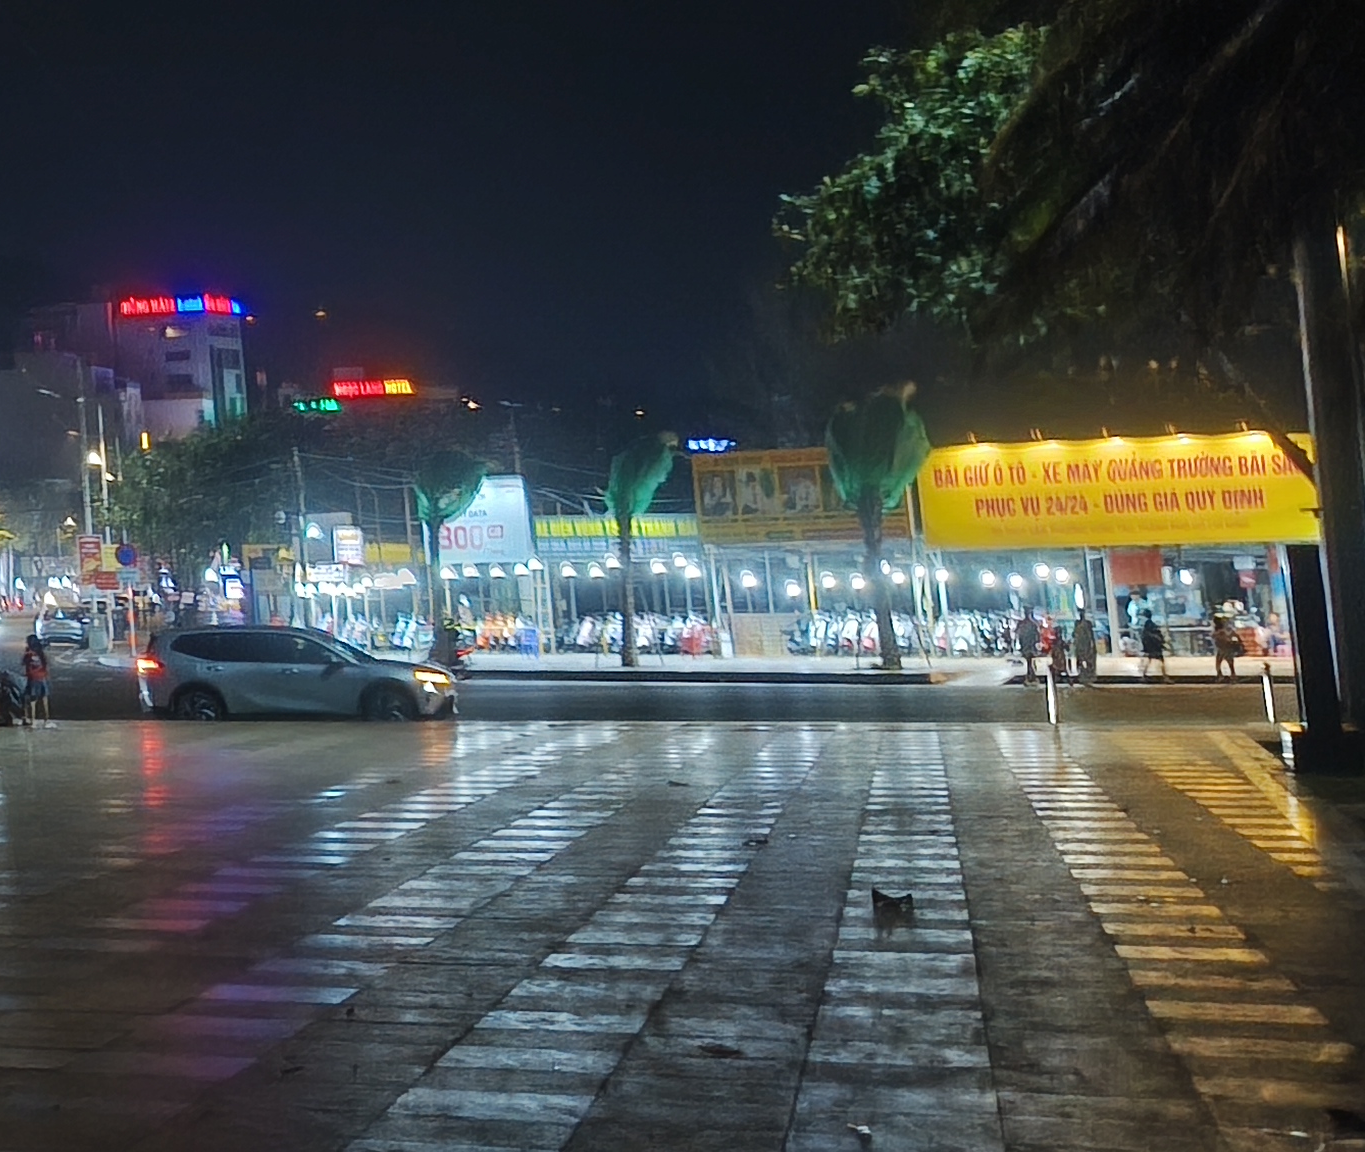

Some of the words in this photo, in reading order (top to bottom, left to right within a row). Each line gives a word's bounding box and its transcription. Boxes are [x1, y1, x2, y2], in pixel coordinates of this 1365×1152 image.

[934, 464, 959, 488] BÃI
[964, 460, 990, 487] GIỮ
[993, 459, 1004, 486] Ô
[1009, 460, 1027, 486] TÔ
[1042, 461, 1062, 485] XE
[1066, 458, 1102, 484] MÁY
[1106, 451, 1164, 483] QUẢNG
[1168, 451, 1234, 479] TRƯỜNG
[1238, 450, 1267, 476] BÃI
[975, 496, 1017, 523] PHỤC
[1021, 495, 1041, 522] VỤ
[1046, 494, 1089, 517] 24/24
[1153, 487, 1181, 512] GIÁ
[1221, 488, 1266, 514] ĐỊNH
